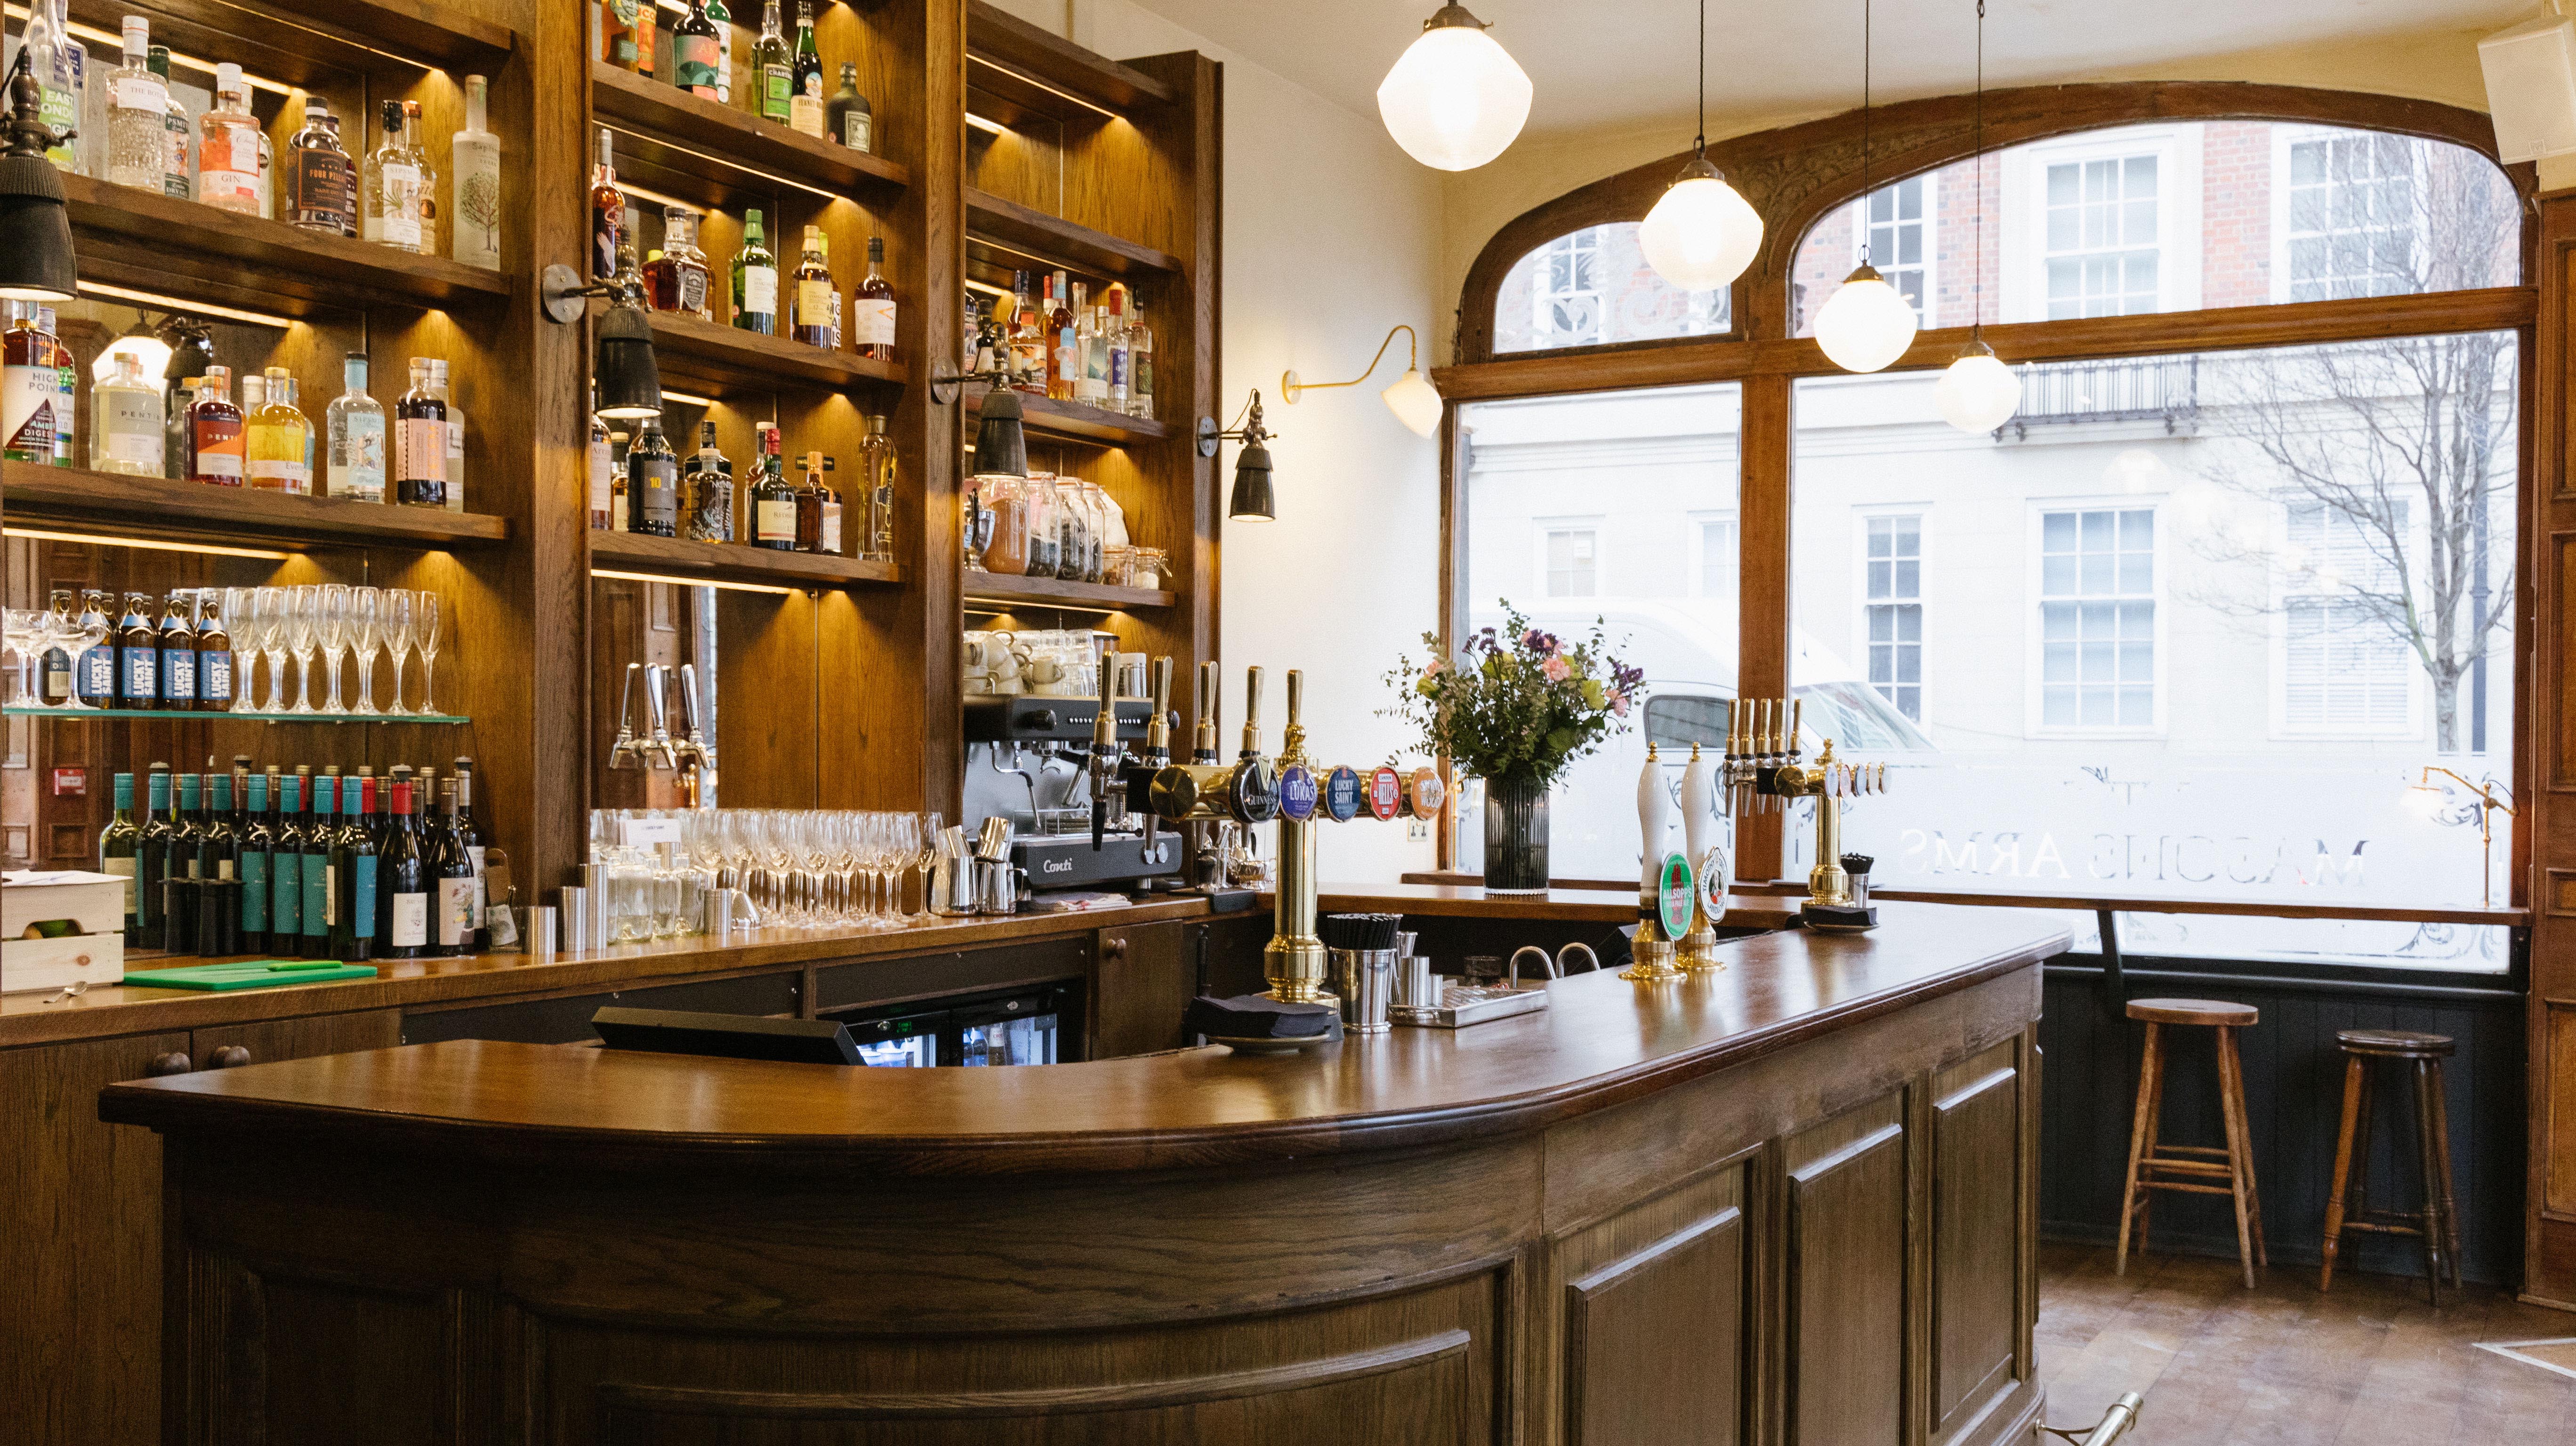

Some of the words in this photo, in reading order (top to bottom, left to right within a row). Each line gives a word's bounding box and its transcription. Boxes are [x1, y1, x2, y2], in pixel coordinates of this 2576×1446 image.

[221, 174, 241, 184] GIN
[309, 169, 327, 179] FOUR
[29, 382, 57, 393] POIN
[91, 657, 102, 694] LUCKY
[102, 658, 112, 695] SAINT
[133, 659, 145, 695] LUCKY
[144, 659, 154, 696] SAINT
[174, 660, 185, 697] LUCKY
[184, 660, 193, 697] SAINT
[211, 661, 222, 698] LUCKY
[221, 662, 230, 697] SAINT
[1289, 784, 1314, 801] LUKAS
[1334, 791, 1353, 804] SAINT
[1335, 780, 1354, 791] LUCKY
[1378, 783, 1393, 805] HELLS
[1248, 794, 1277, 805] GUINNESS
[1043, 857, 1072, 873] Conti
[1702, 860, 1715, 893] TIMOTHY
